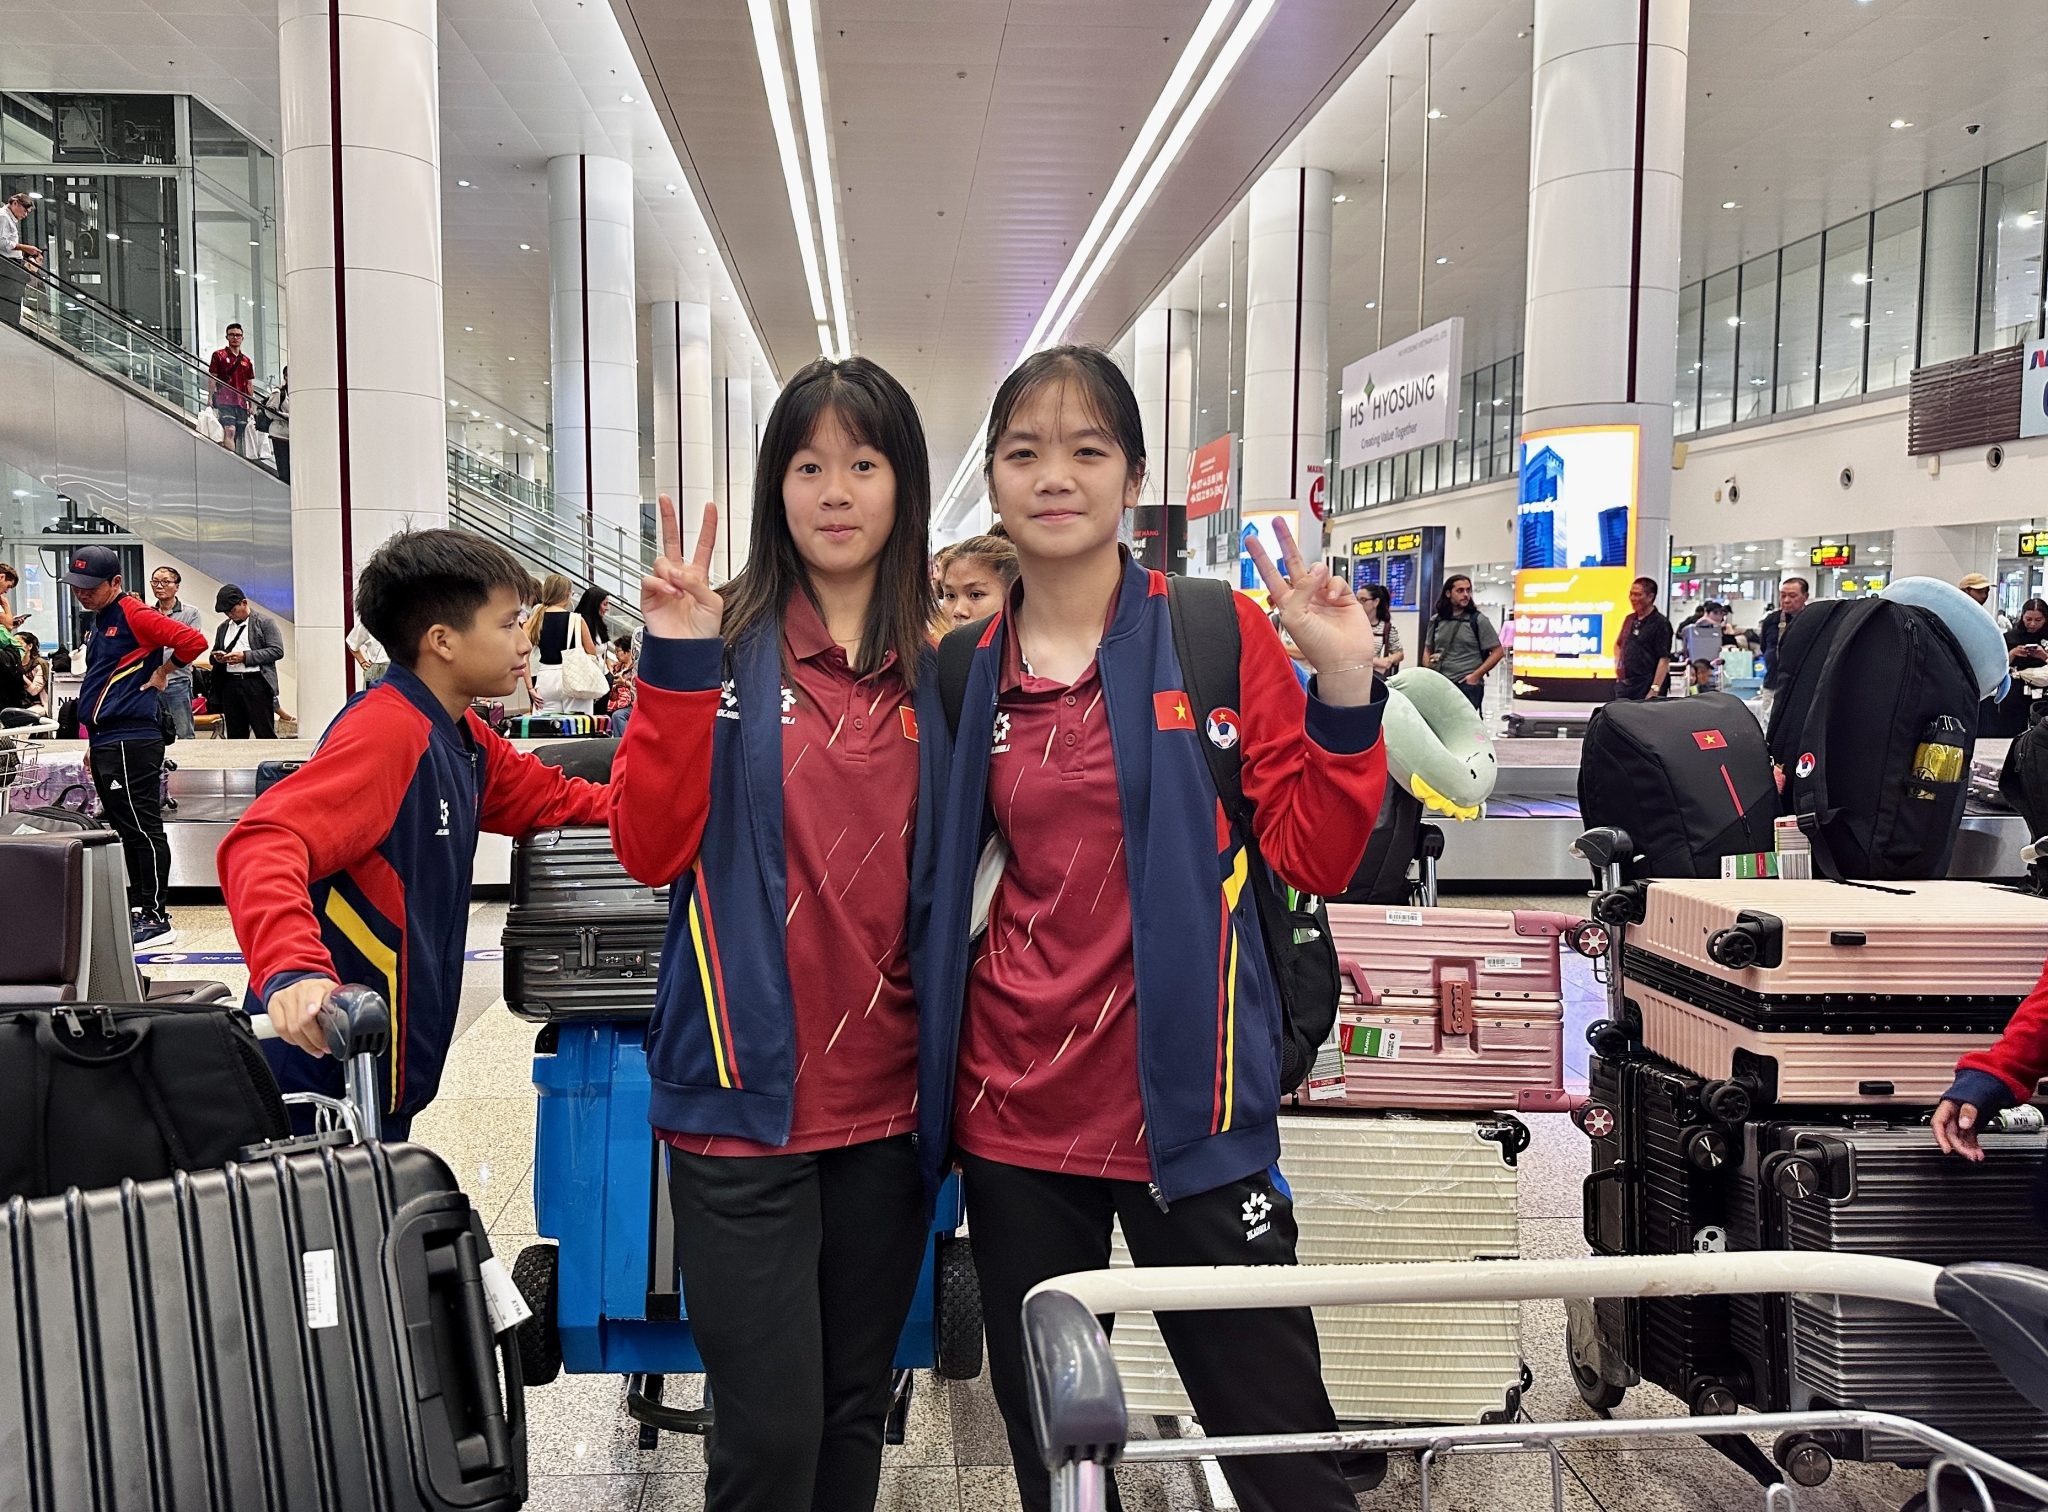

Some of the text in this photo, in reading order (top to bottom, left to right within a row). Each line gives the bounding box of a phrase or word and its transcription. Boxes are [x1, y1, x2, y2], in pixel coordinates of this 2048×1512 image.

[1350, 374, 1435, 429] HS HYOSUNG
[1361, 422, 1418, 450] Creating Value Together
[1548, 614, 1590, 634] NĂM
